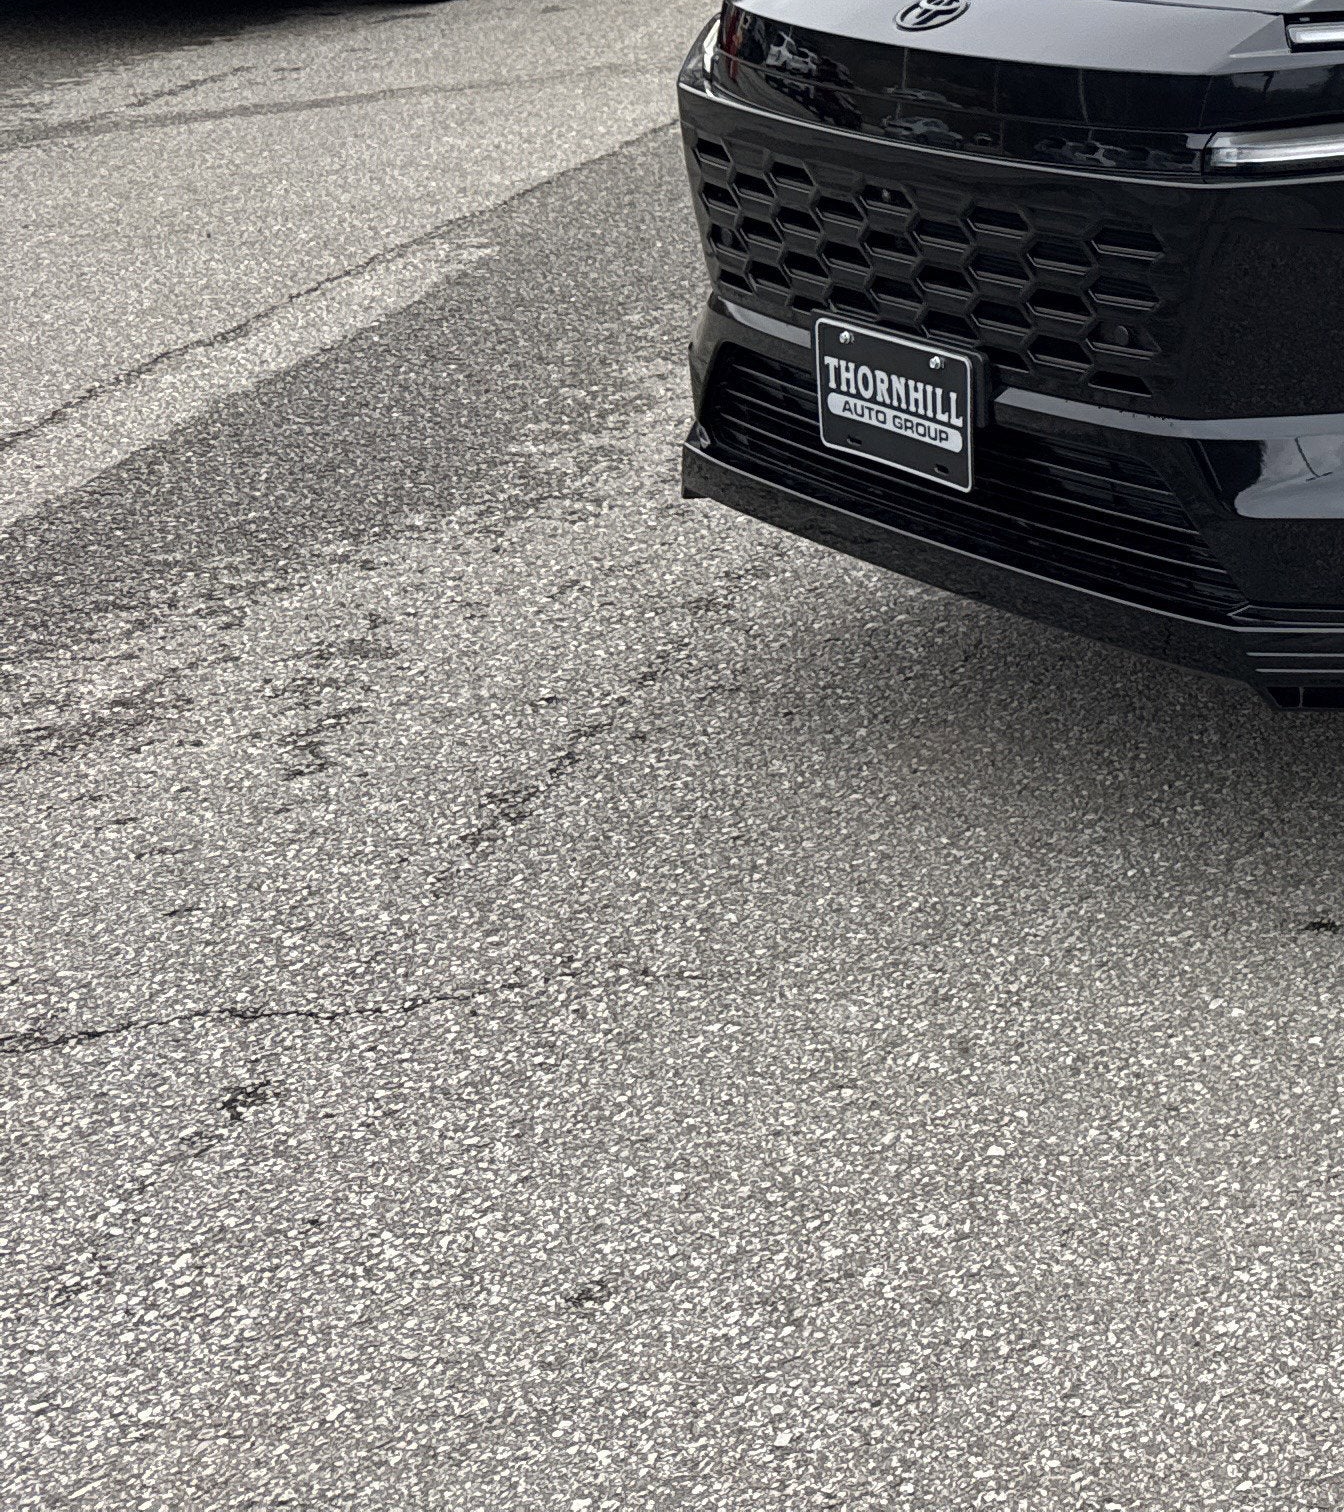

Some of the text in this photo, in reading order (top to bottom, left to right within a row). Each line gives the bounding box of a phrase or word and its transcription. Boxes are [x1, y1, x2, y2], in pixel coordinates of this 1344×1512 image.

[824, 356, 963, 427] THORNHILL
[842, 400, 949, 443] AUTO GROUP
